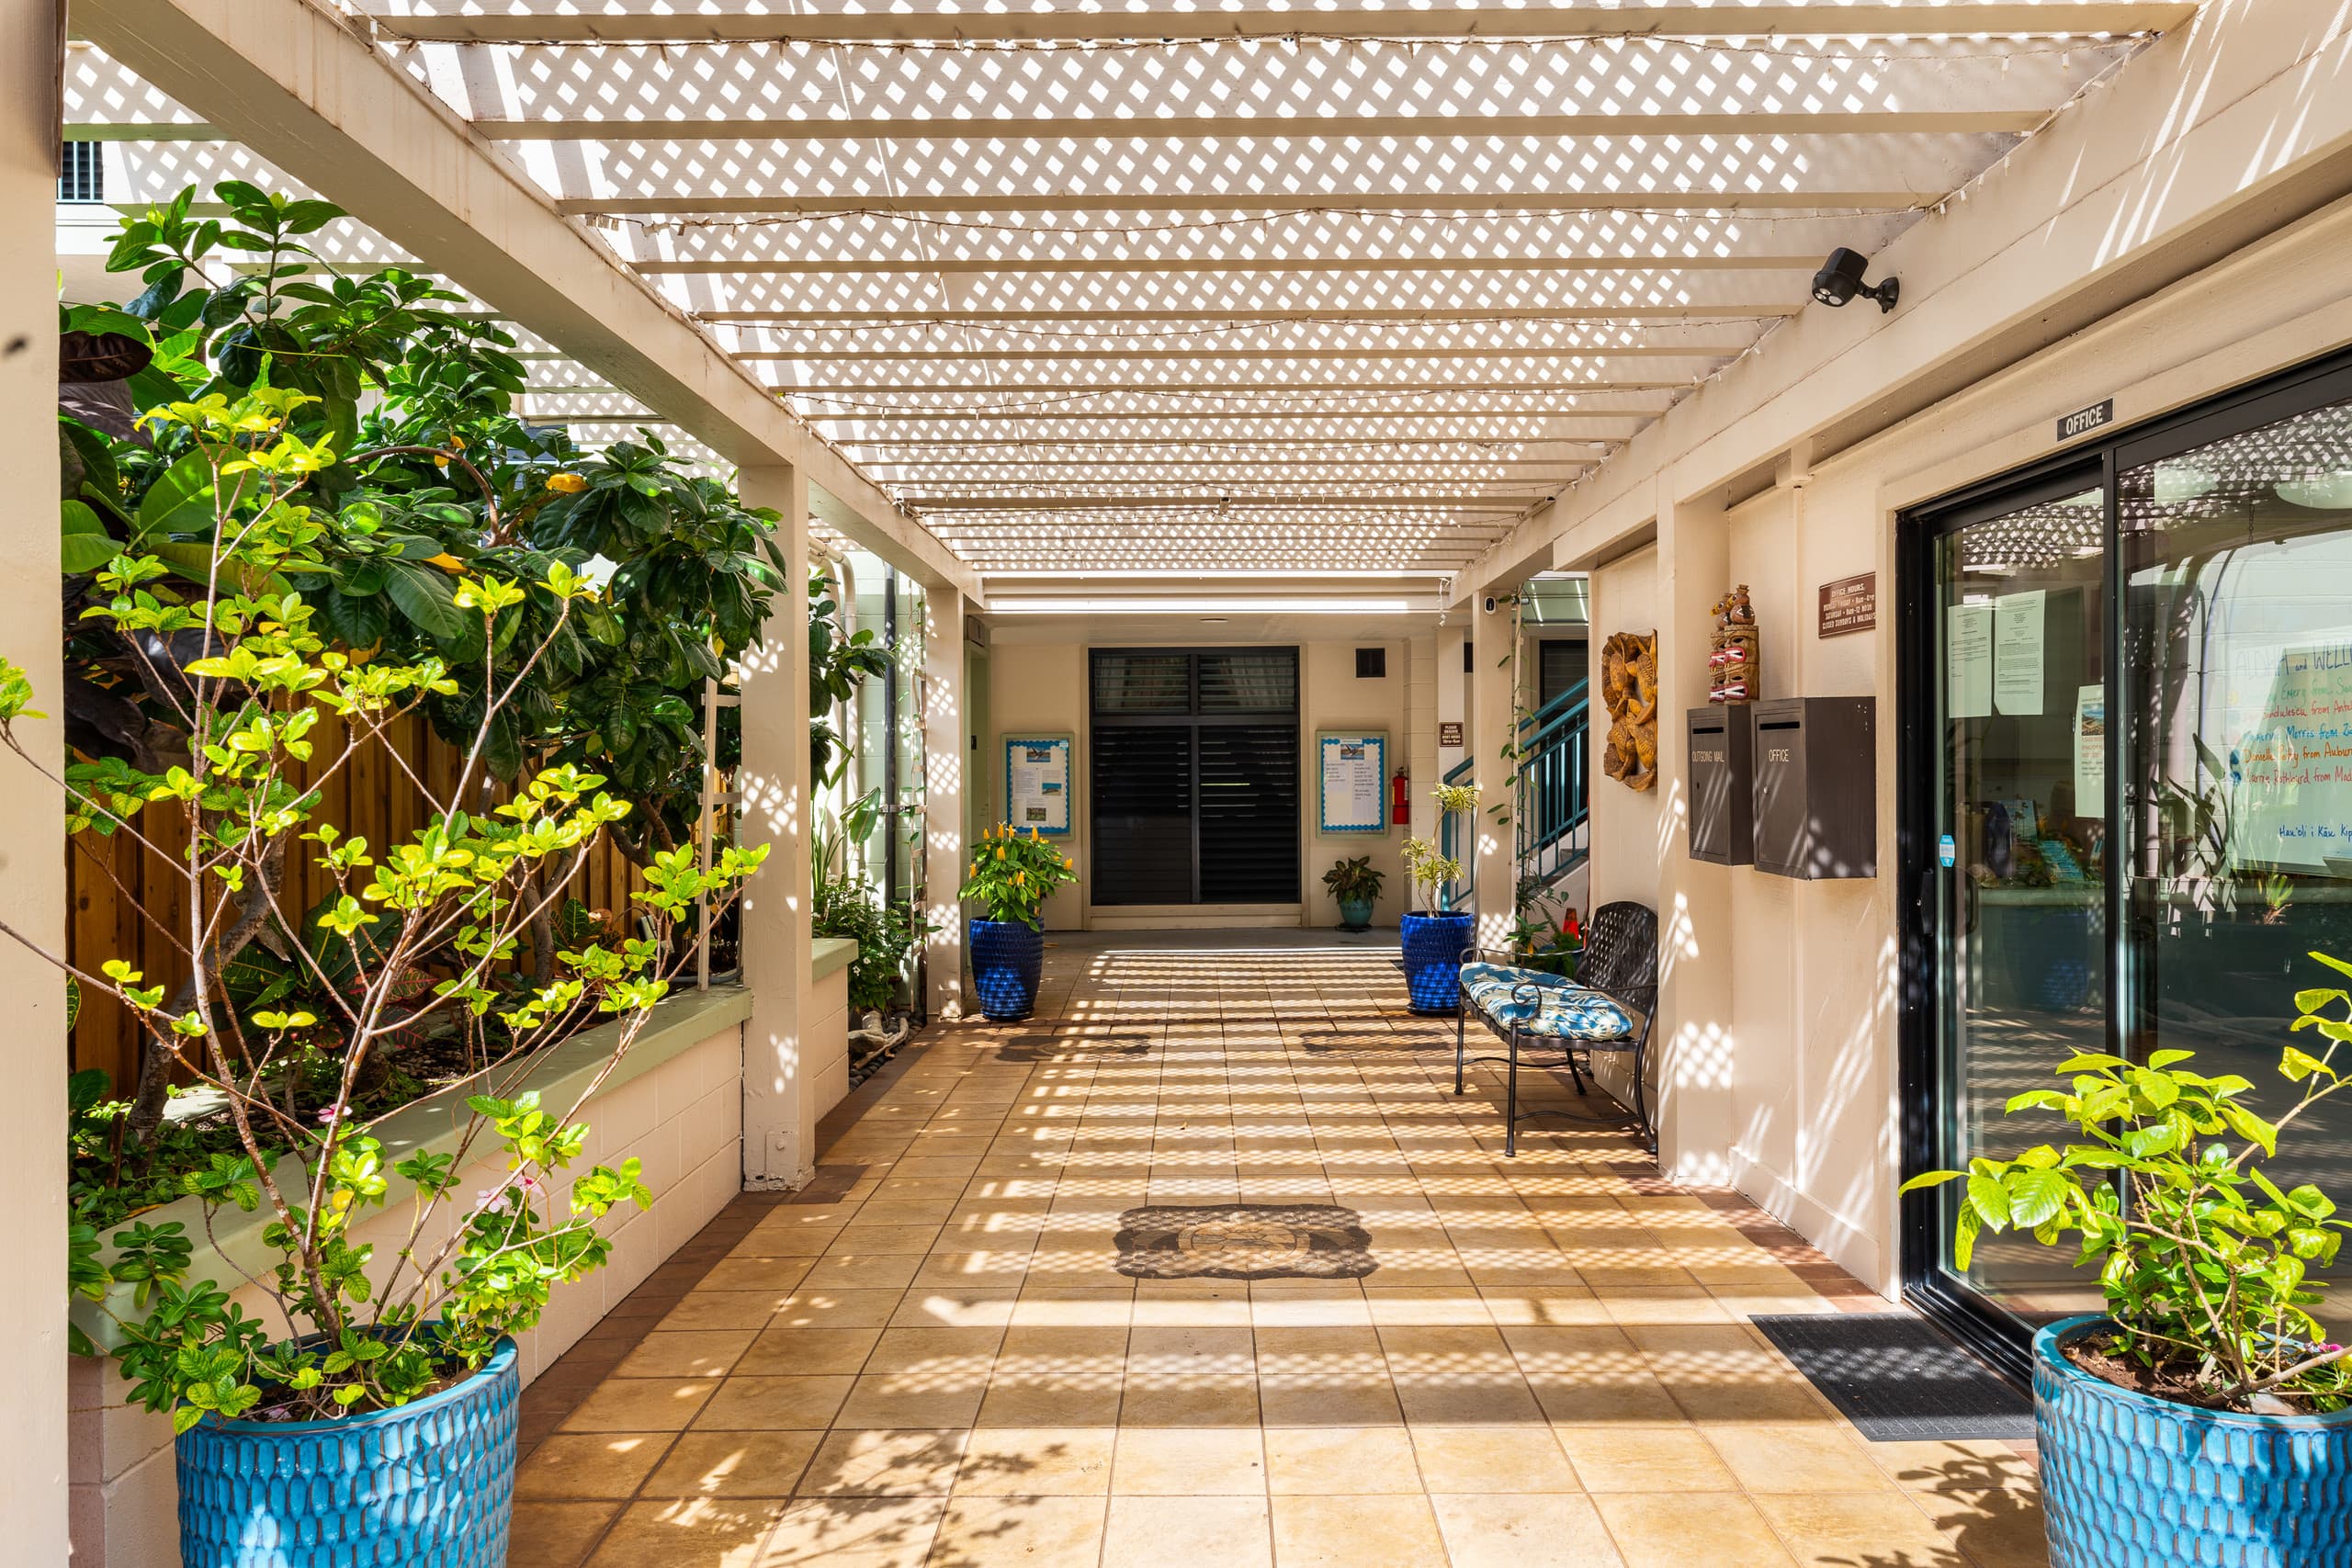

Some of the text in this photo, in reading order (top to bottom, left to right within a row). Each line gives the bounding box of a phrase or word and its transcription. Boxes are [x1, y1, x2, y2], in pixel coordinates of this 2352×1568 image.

[2065, 405, 2104, 435] OFFICE
[1831, 582, 1865, 598] OFFICE HOURS
[2295, 658, 2308, 671] and
[2311, 700, 2330, 716] from
[2287, 725, 2314, 740] Morris
[2319, 723, 2338, 739] from
[1691, 750, 1724, 762] OUTGOING MAIL
[1768, 749, 1790, 762] OFFICE
[2302, 746, 2321, 761] from
[2314, 767, 2331, 783] from
